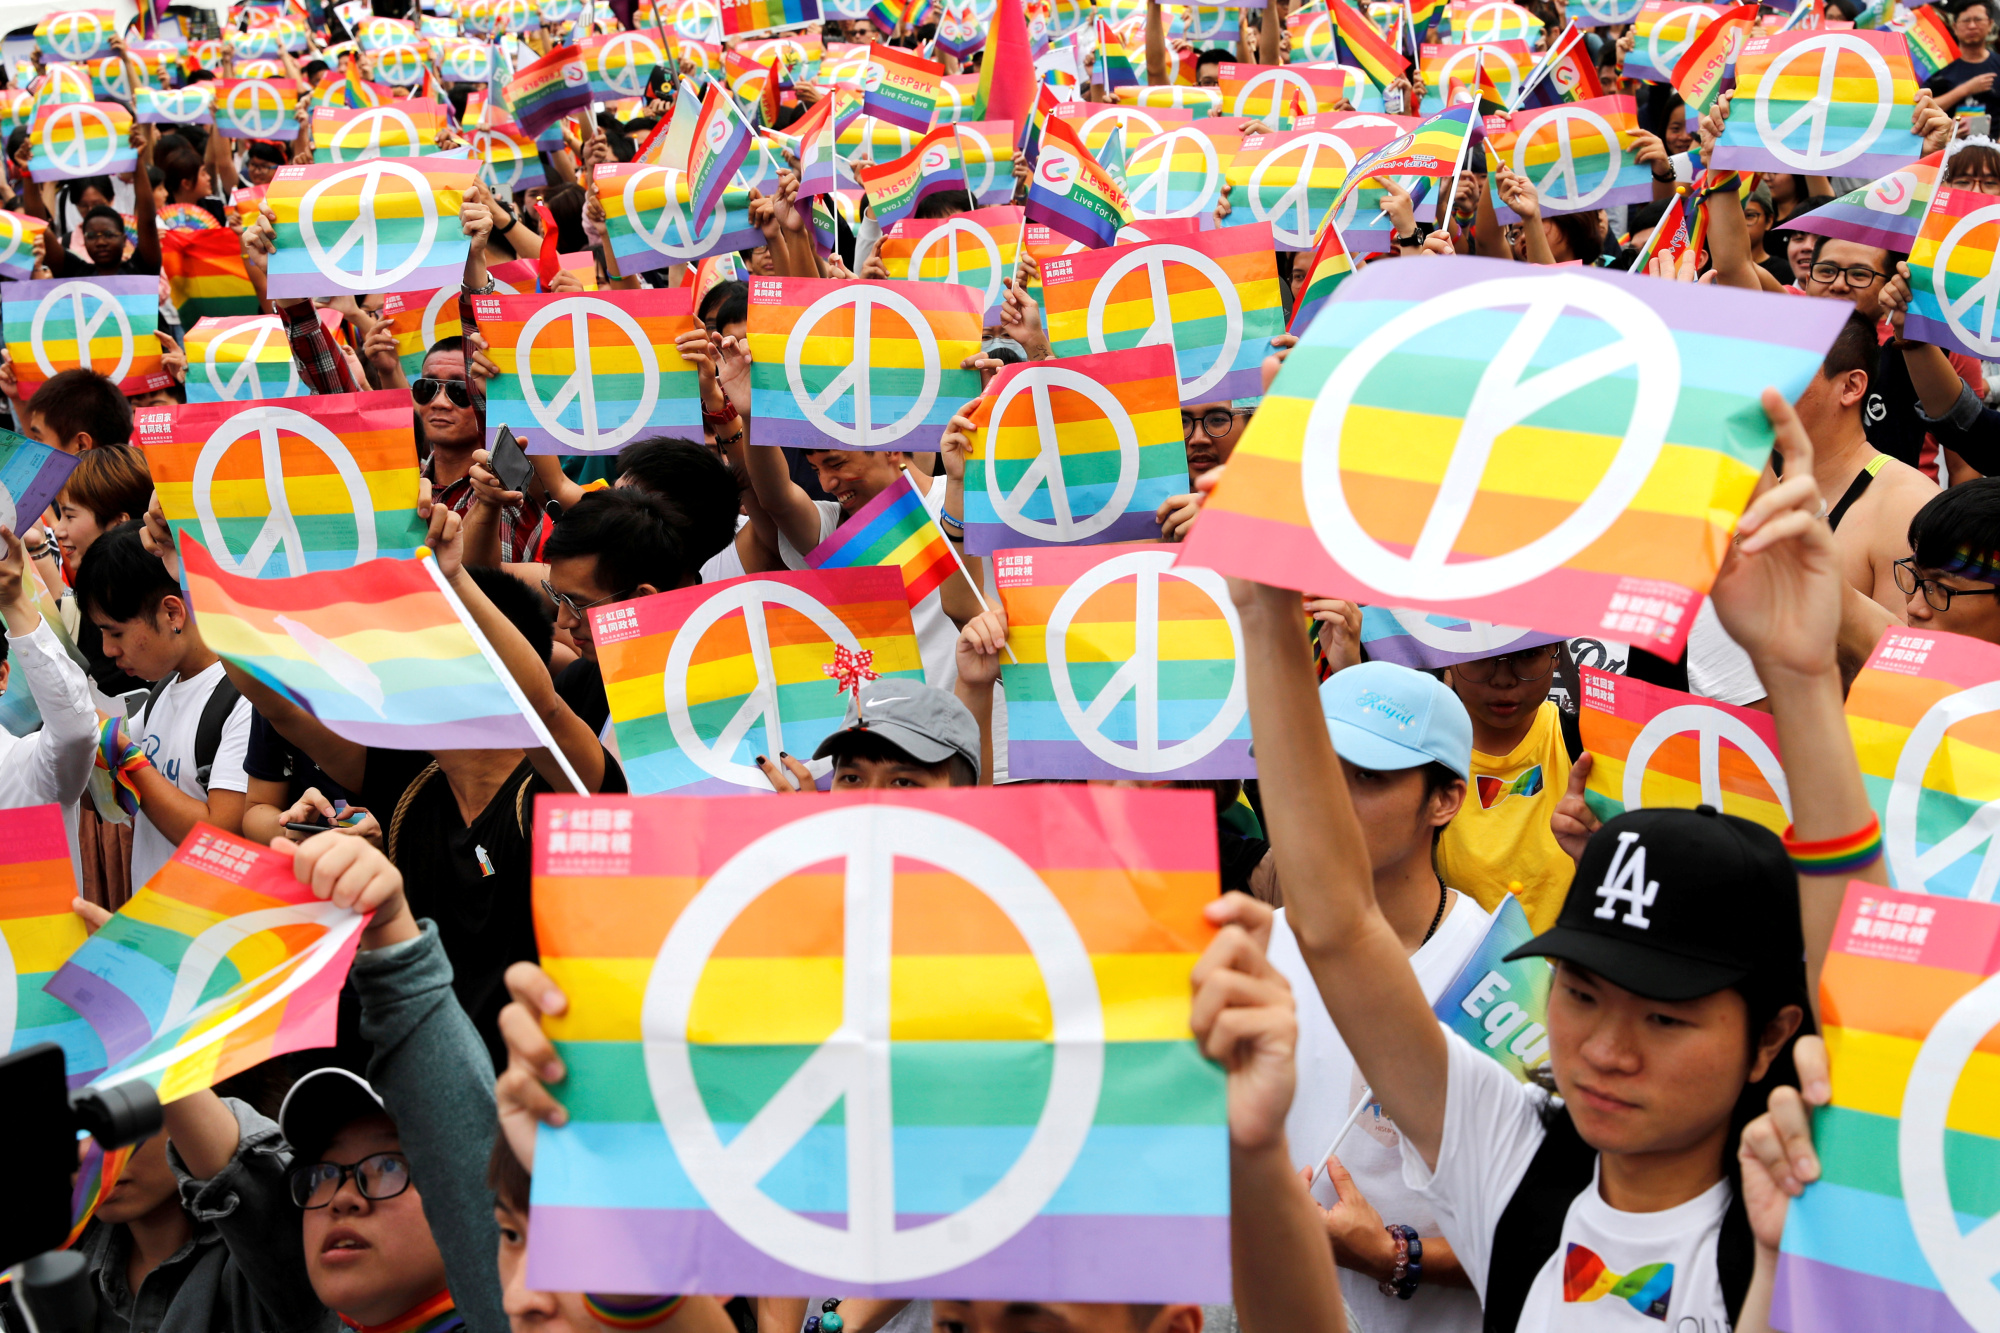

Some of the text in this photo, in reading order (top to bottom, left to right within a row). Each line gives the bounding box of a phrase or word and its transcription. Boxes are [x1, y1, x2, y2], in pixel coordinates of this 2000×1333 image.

[885, 70, 931, 94] LesPark
[880, 88, 928, 109] Live For Love
[1079, 166, 1131, 211] LesPark
[1073, 191, 1093, 208] Live
[1095, 203, 1108, 218] For
[813, 217, 830, 230] ove
[1045, 260, 1072, 270] 彩虹回家
[754, 281, 782, 289] 彩虹回家
[140, 413, 171, 423] 彩虹回家
[998, 556, 1032, 566] 彩虹回家
[595, 607, 635, 624] 彩虹回家
[1887, 635, 1935, 651] 彩虹回家
[1585, 674, 1615, 691] 彩虹回家
[1355, 692, 1415, 726] Royal
[1594, 831, 1659, 929] LA
